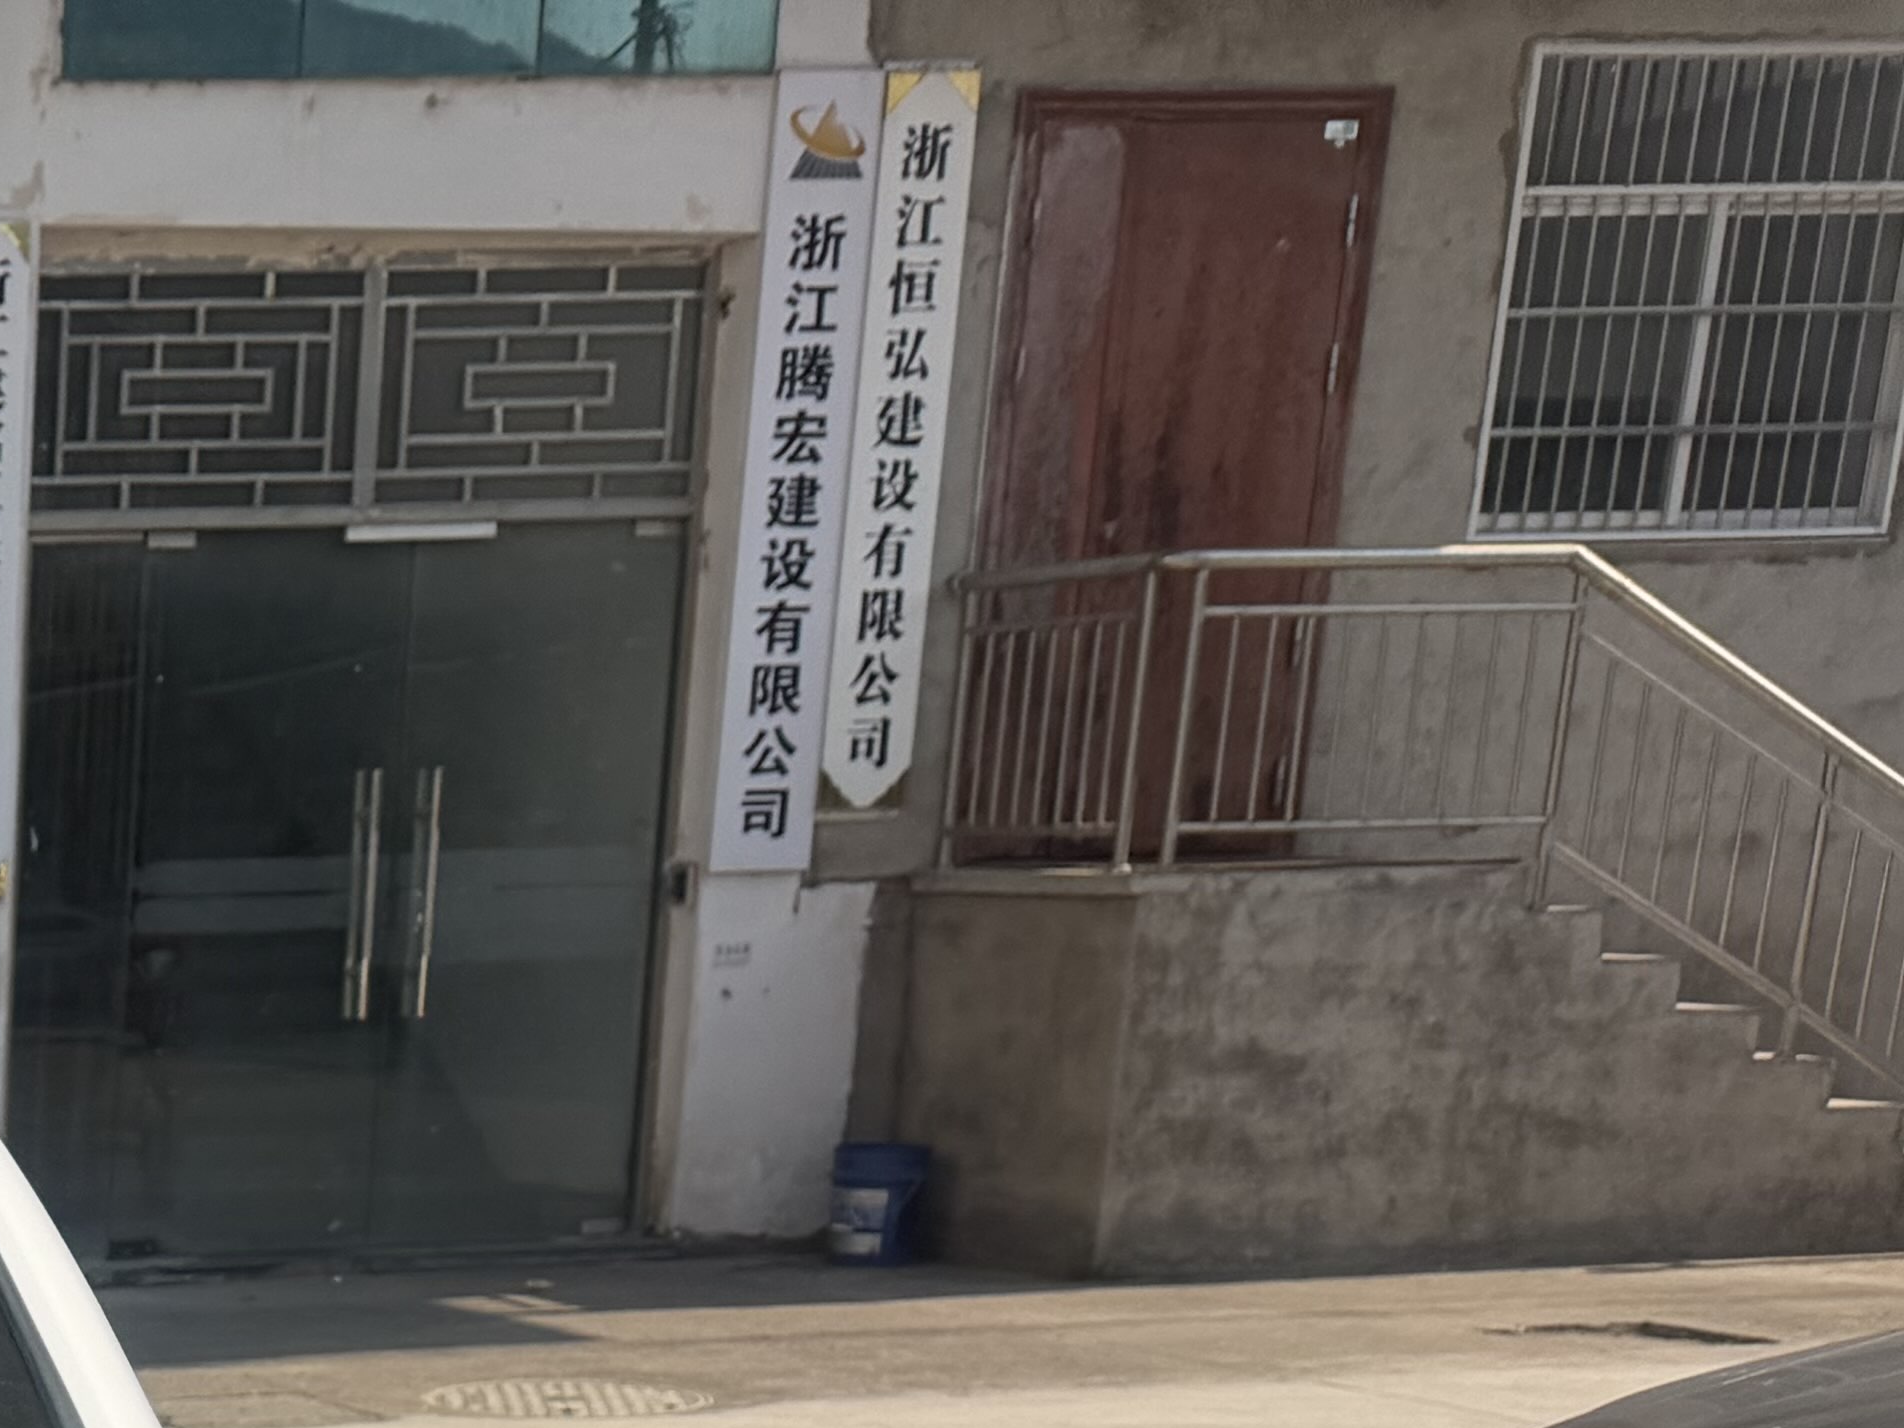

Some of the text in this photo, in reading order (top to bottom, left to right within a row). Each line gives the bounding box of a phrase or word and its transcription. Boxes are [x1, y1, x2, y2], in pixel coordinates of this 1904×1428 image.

[740, 213, 847, 840] 浙江腾宏建设有限公司
[846, 122, 954, 769] 浙江恒弘建设有限公司
